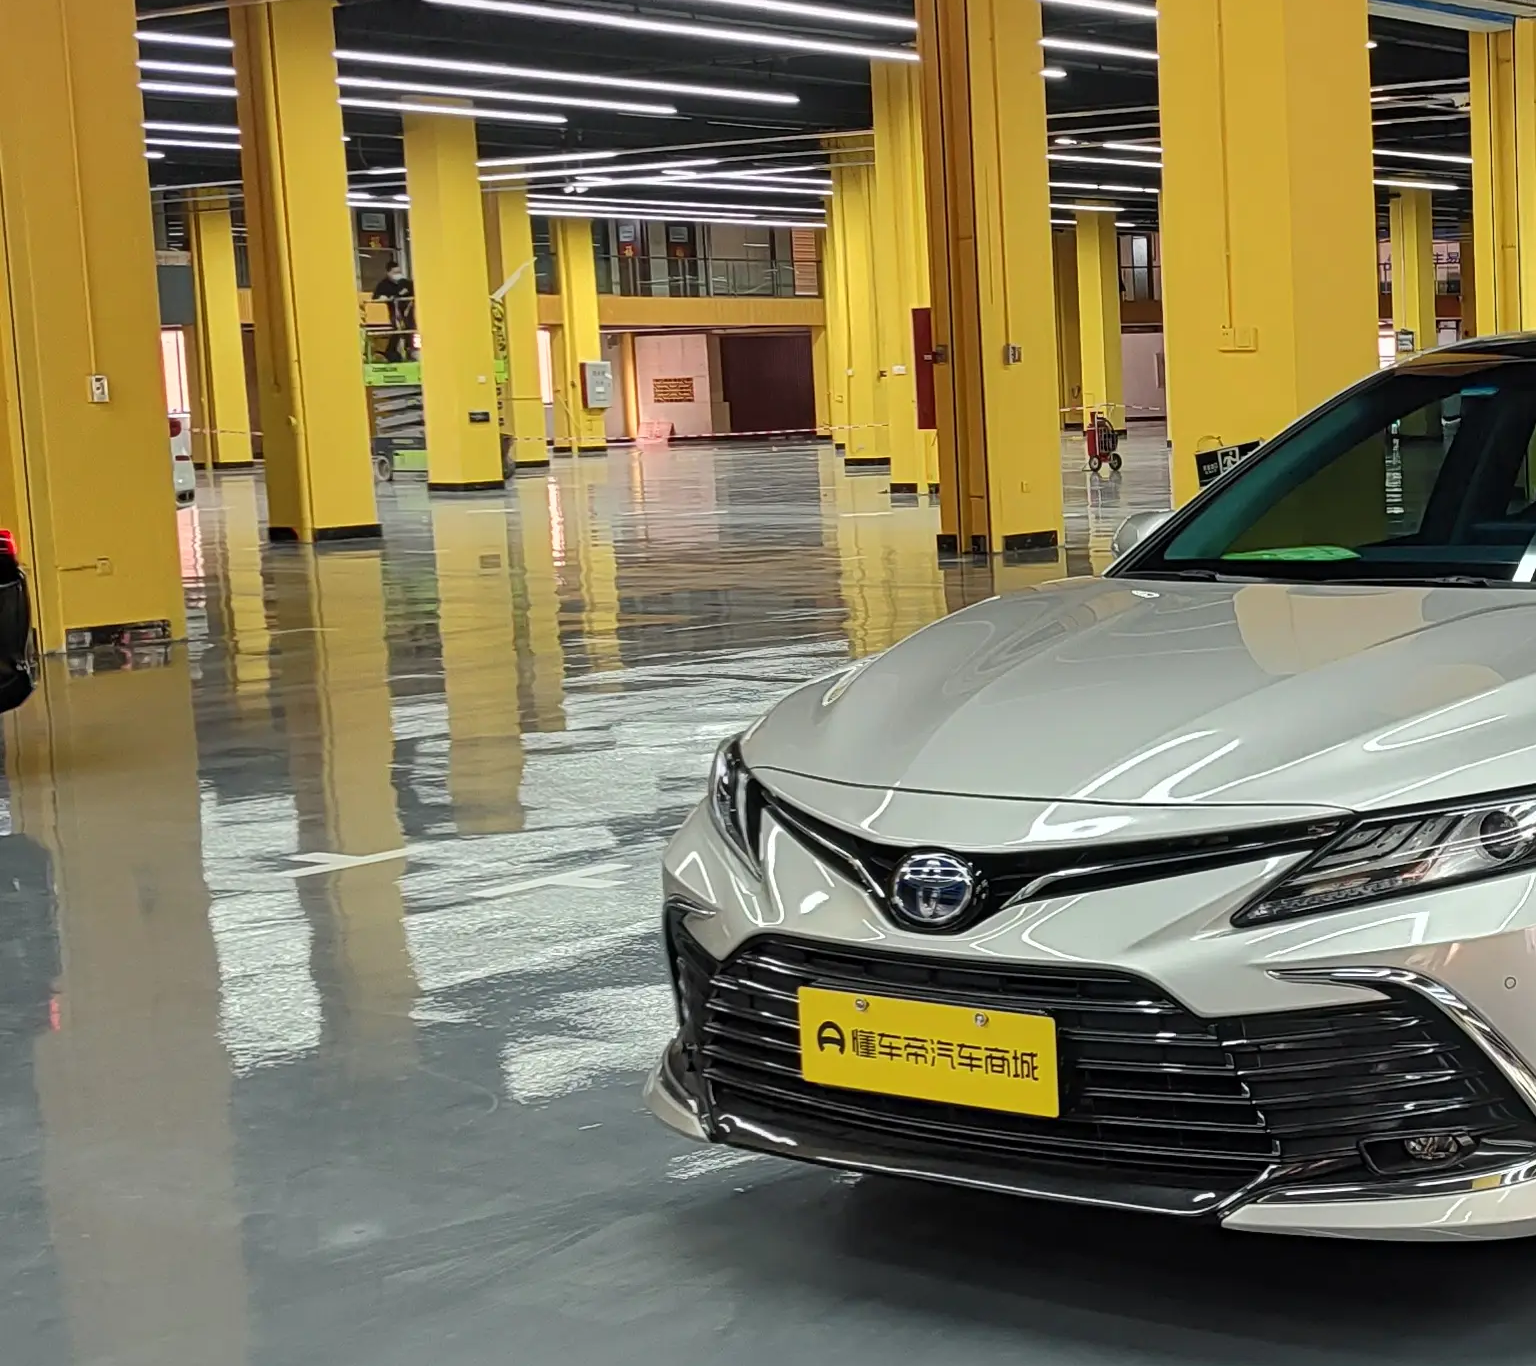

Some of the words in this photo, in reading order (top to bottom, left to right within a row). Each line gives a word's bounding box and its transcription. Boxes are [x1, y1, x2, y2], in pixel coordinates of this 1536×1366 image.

[851, 1028, 1040, 1082] 懂车帝汽车商城
